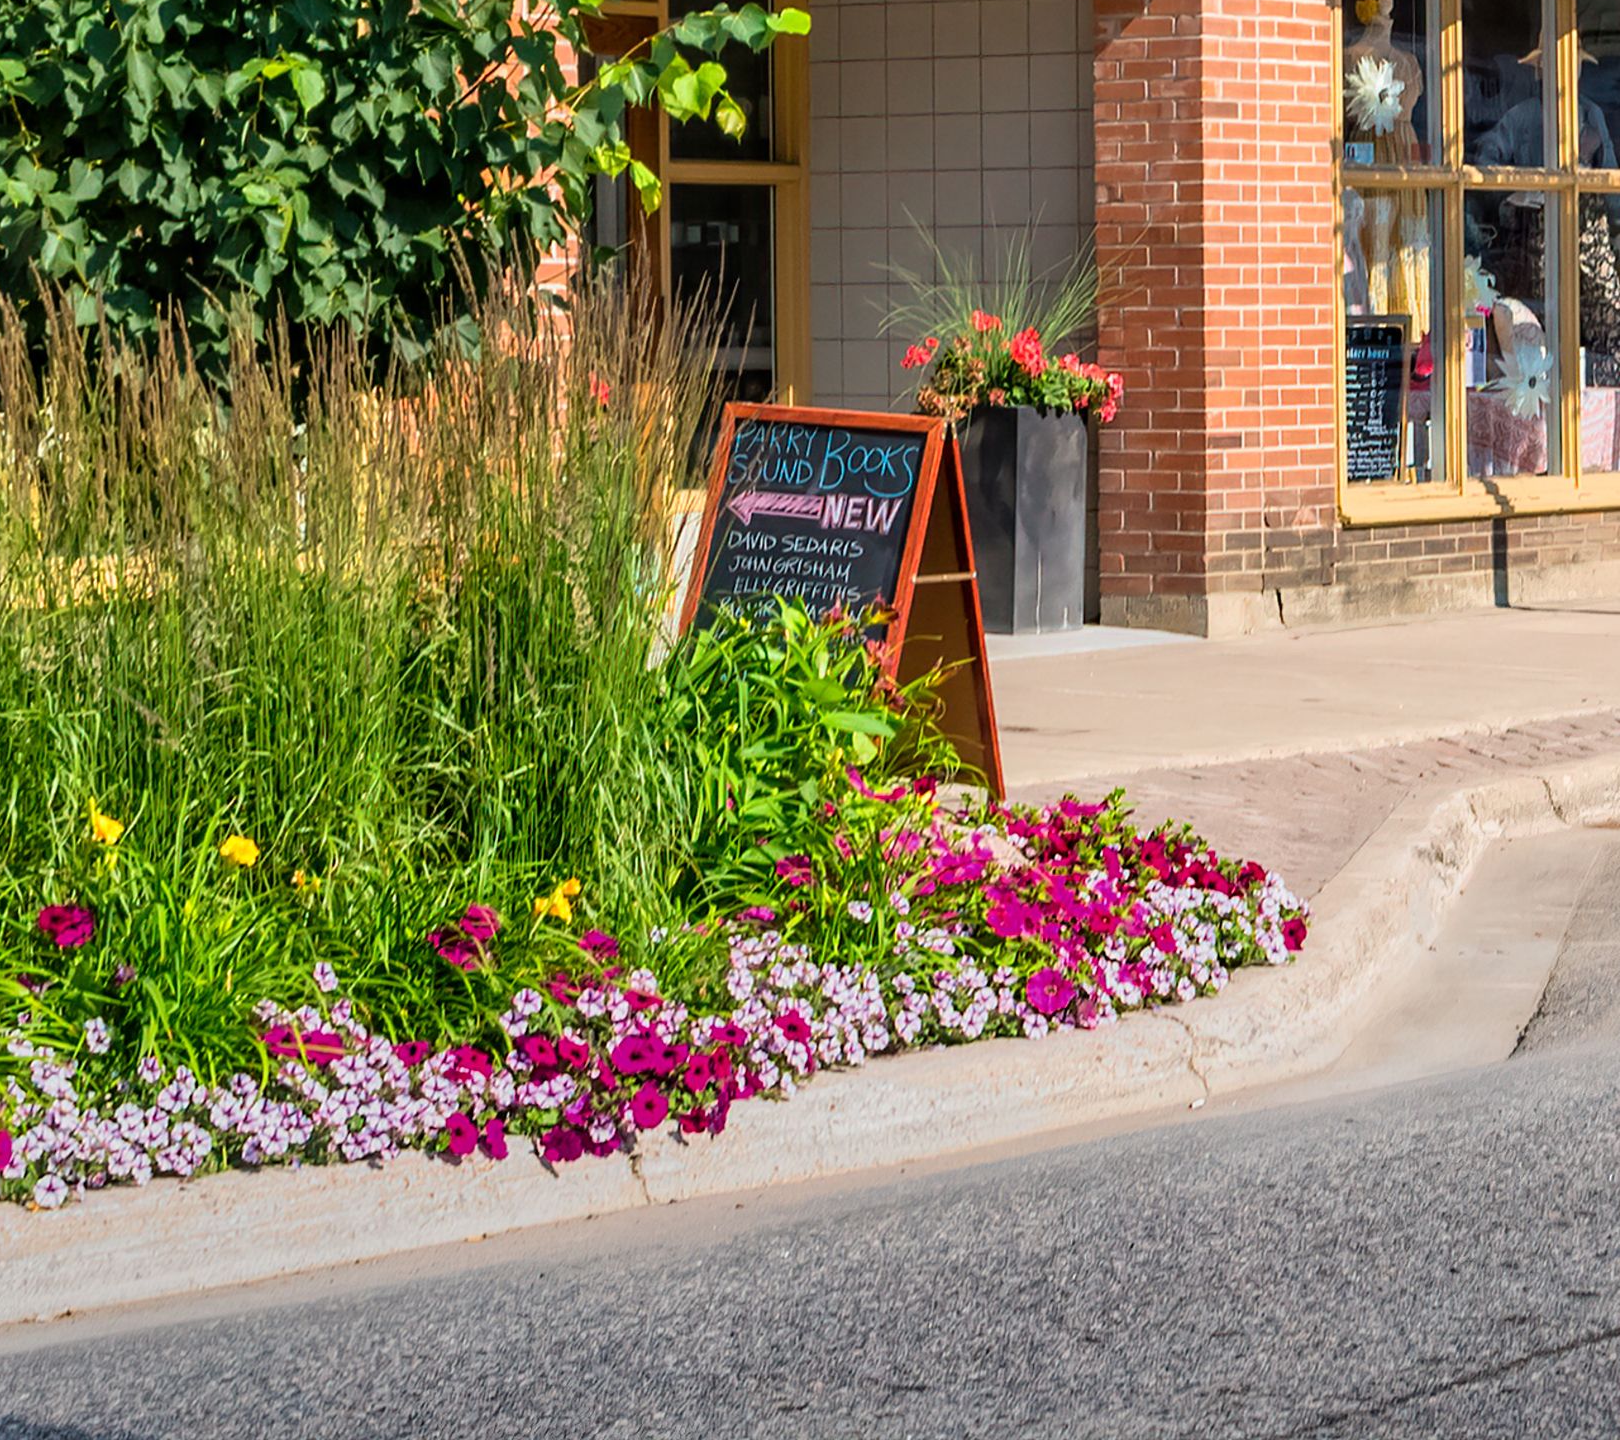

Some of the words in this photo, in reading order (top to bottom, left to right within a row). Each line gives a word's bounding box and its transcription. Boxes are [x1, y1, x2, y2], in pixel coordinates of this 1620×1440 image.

[734, 422, 819, 458] PARRY
[728, 453, 814, 485] SOUND
[820, 493, 904, 536] NEW
[727, 530, 777, 552] DAVID
[781, 533, 865, 558] SEDARIS
[728, 555, 772, 573] JOHN
[772, 557, 852, 583] GRISHAM
[733, 575, 773, 595] ELLY
[772, 577, 862, 604] GRIFFITHS
